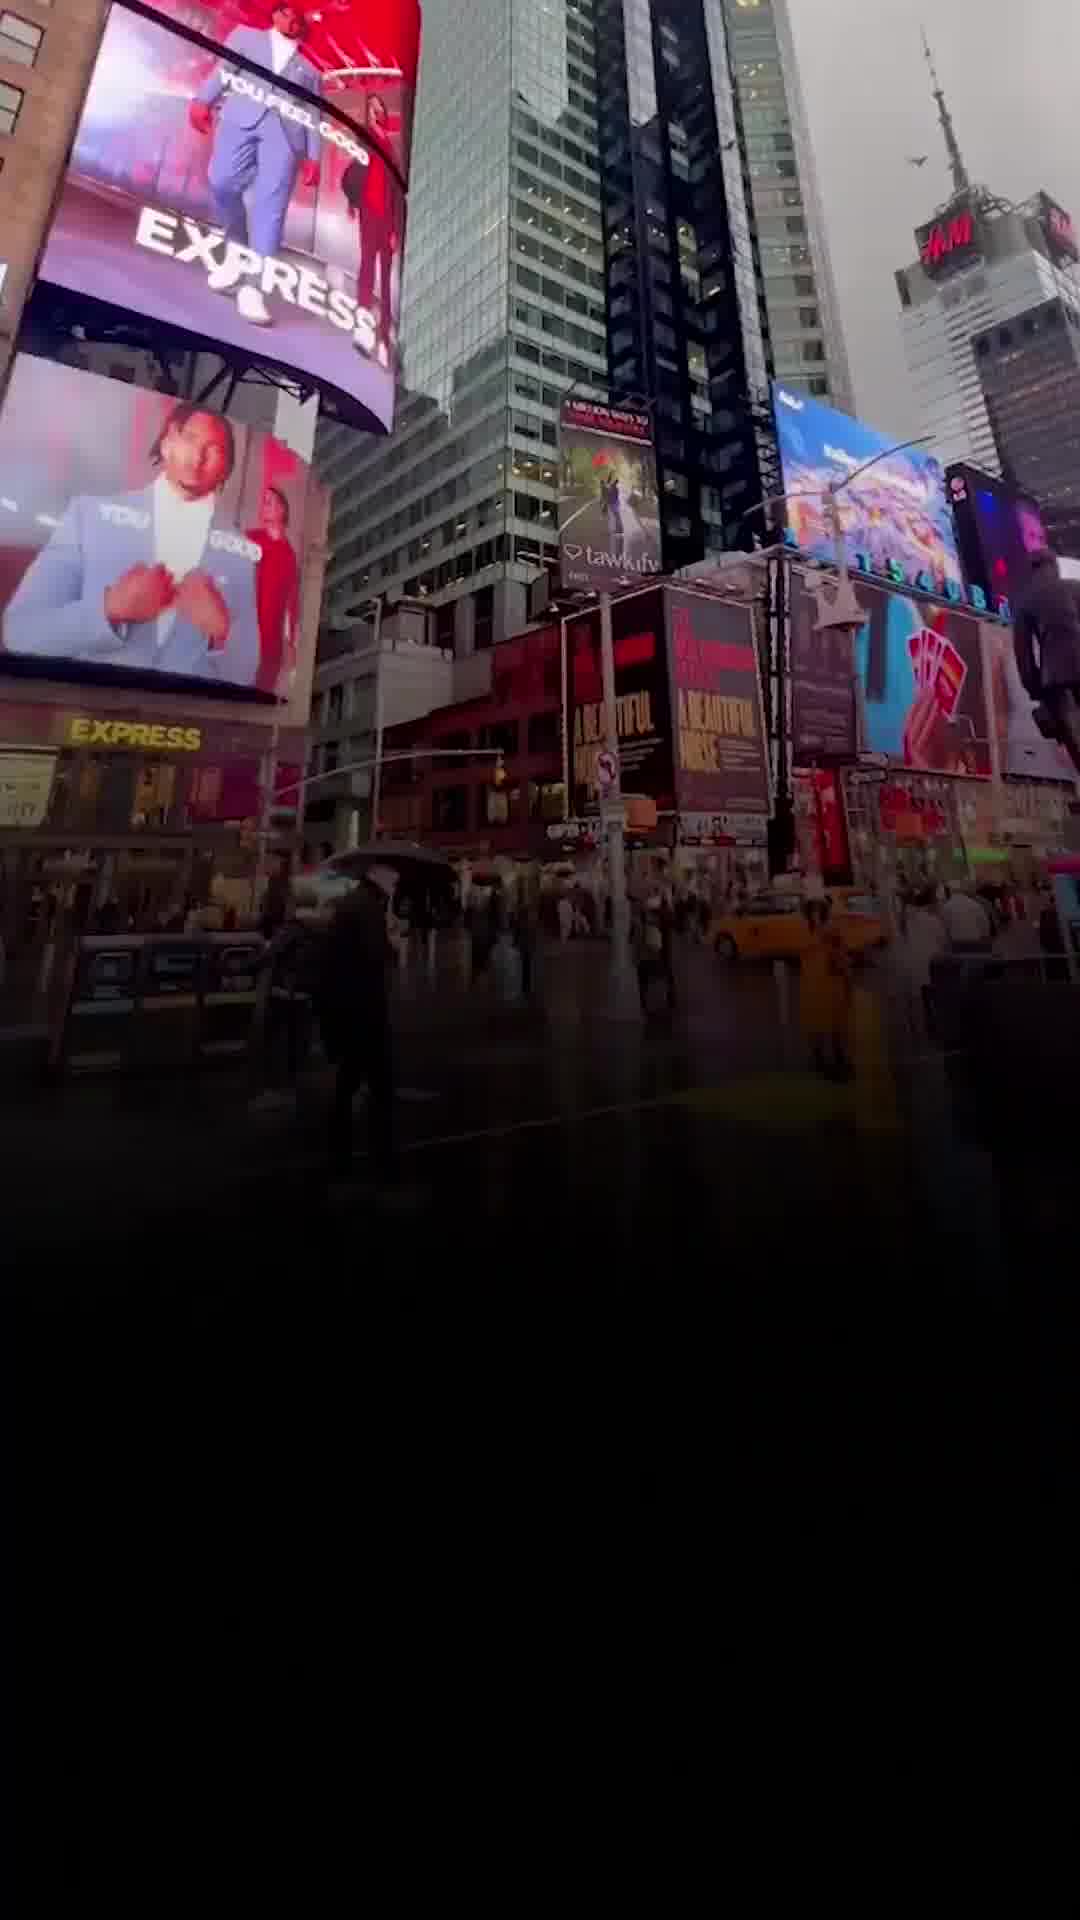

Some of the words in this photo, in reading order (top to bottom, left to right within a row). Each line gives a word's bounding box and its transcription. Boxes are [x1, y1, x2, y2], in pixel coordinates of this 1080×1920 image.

[218, 69, 265, 104] YOU
[265, 93, 315, 129] FEEL
[319, 120, 369, 166] GOOD
[136, 206, 379, 354] EXPRESS
[99, 503, 151, 529] YOU
[209, 529, 263, 562] GOOD
[586, 545, 662, 573] tawkify
[71, 718, 201, 752] EXPRESS
